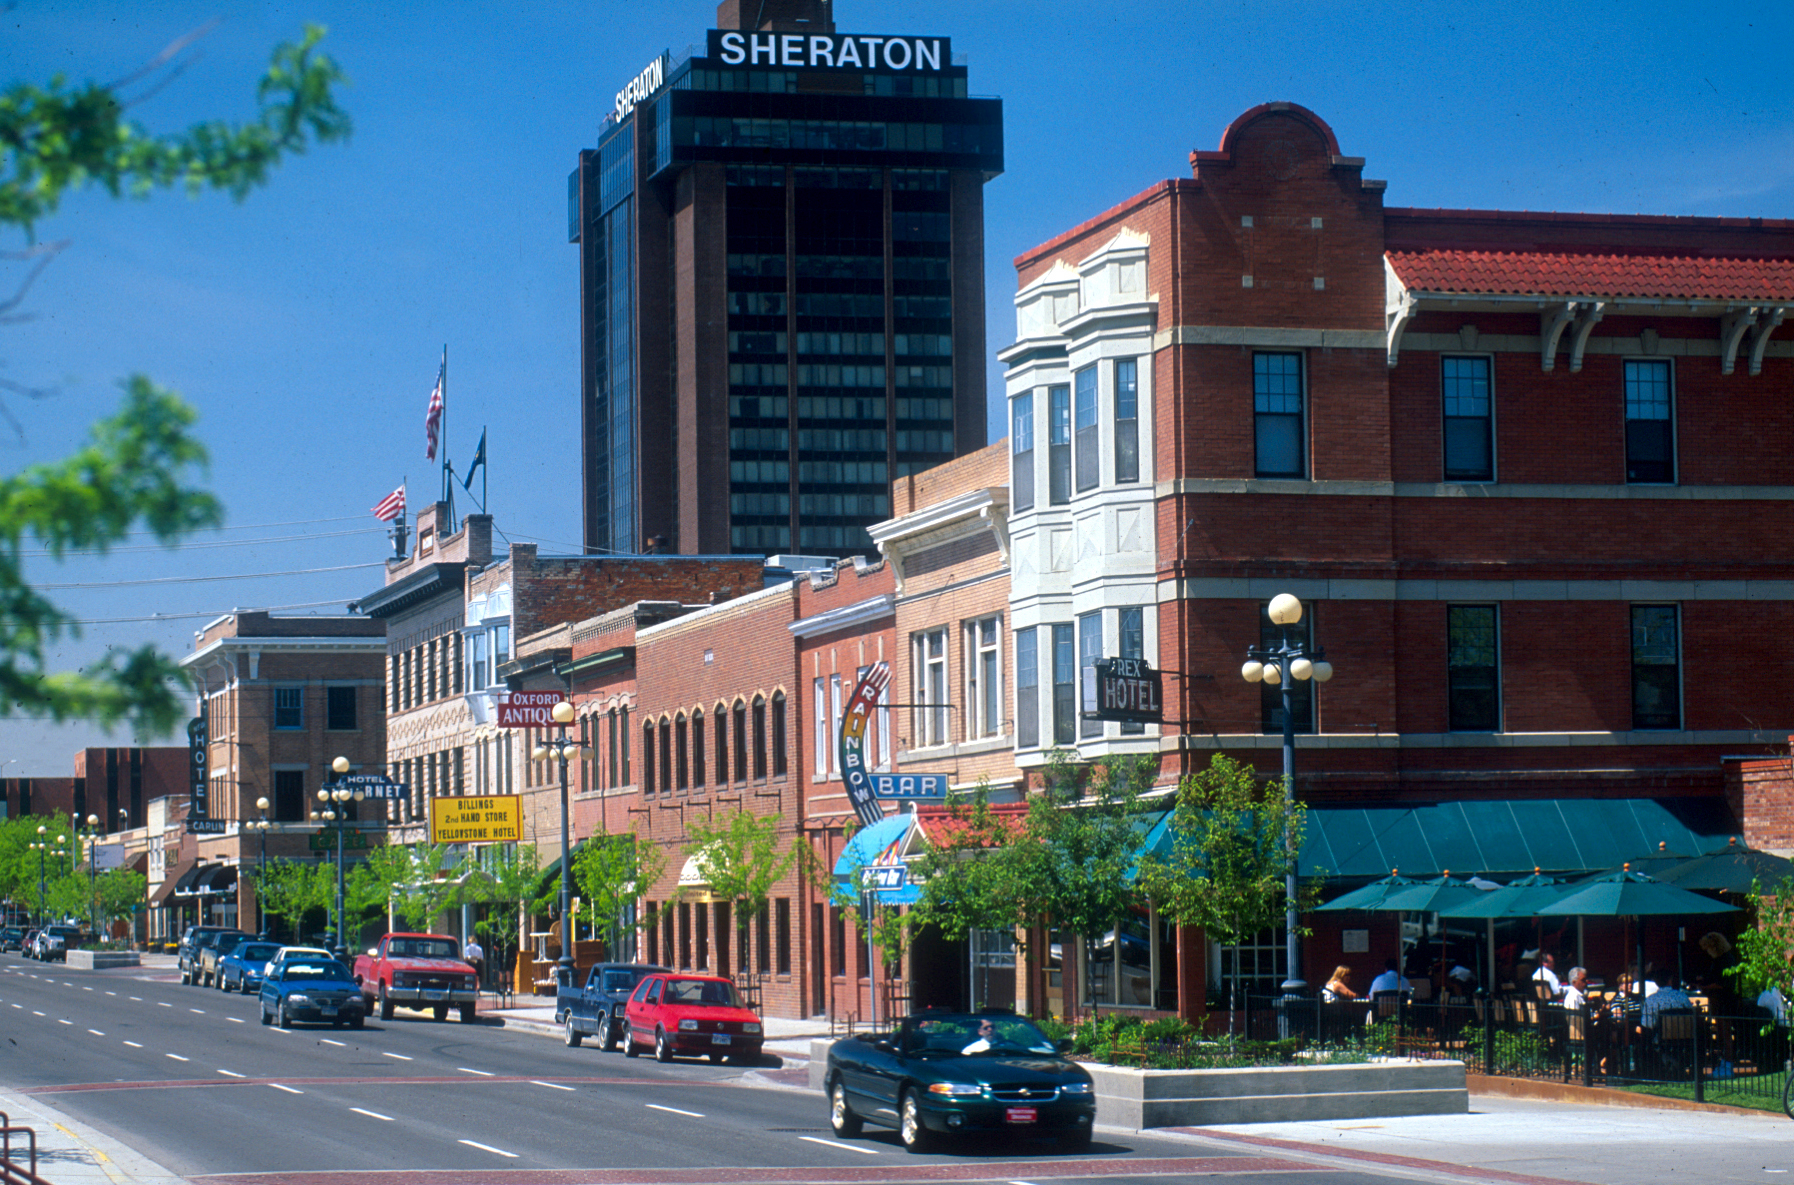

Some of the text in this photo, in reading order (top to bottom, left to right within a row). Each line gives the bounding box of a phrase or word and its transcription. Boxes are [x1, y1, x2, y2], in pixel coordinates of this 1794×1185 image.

[720, 32, 941, 70] SHERATON
[615, 54, 663, 123] SHERATON
[1117, 659, 1141, 677] REX
[513, 693, 560, 705] OXFORD
[1104, 677, 1158, 711] HOTEL
[503, 707, 569, 726] ANTIQU
[845, 685, 875, 803] RAINBOW
[195, 734, 205, 814] HOTEL
[879, 777, 937, 795] BAR
[458, 799, 494, 810] BILLINGS
[193, 821, 225, 831] CARLIN
[445, 812, 508, 823] 2nd HAND STORE
[438, 827, 516, 839] YELLOWSTONE HOTEL
